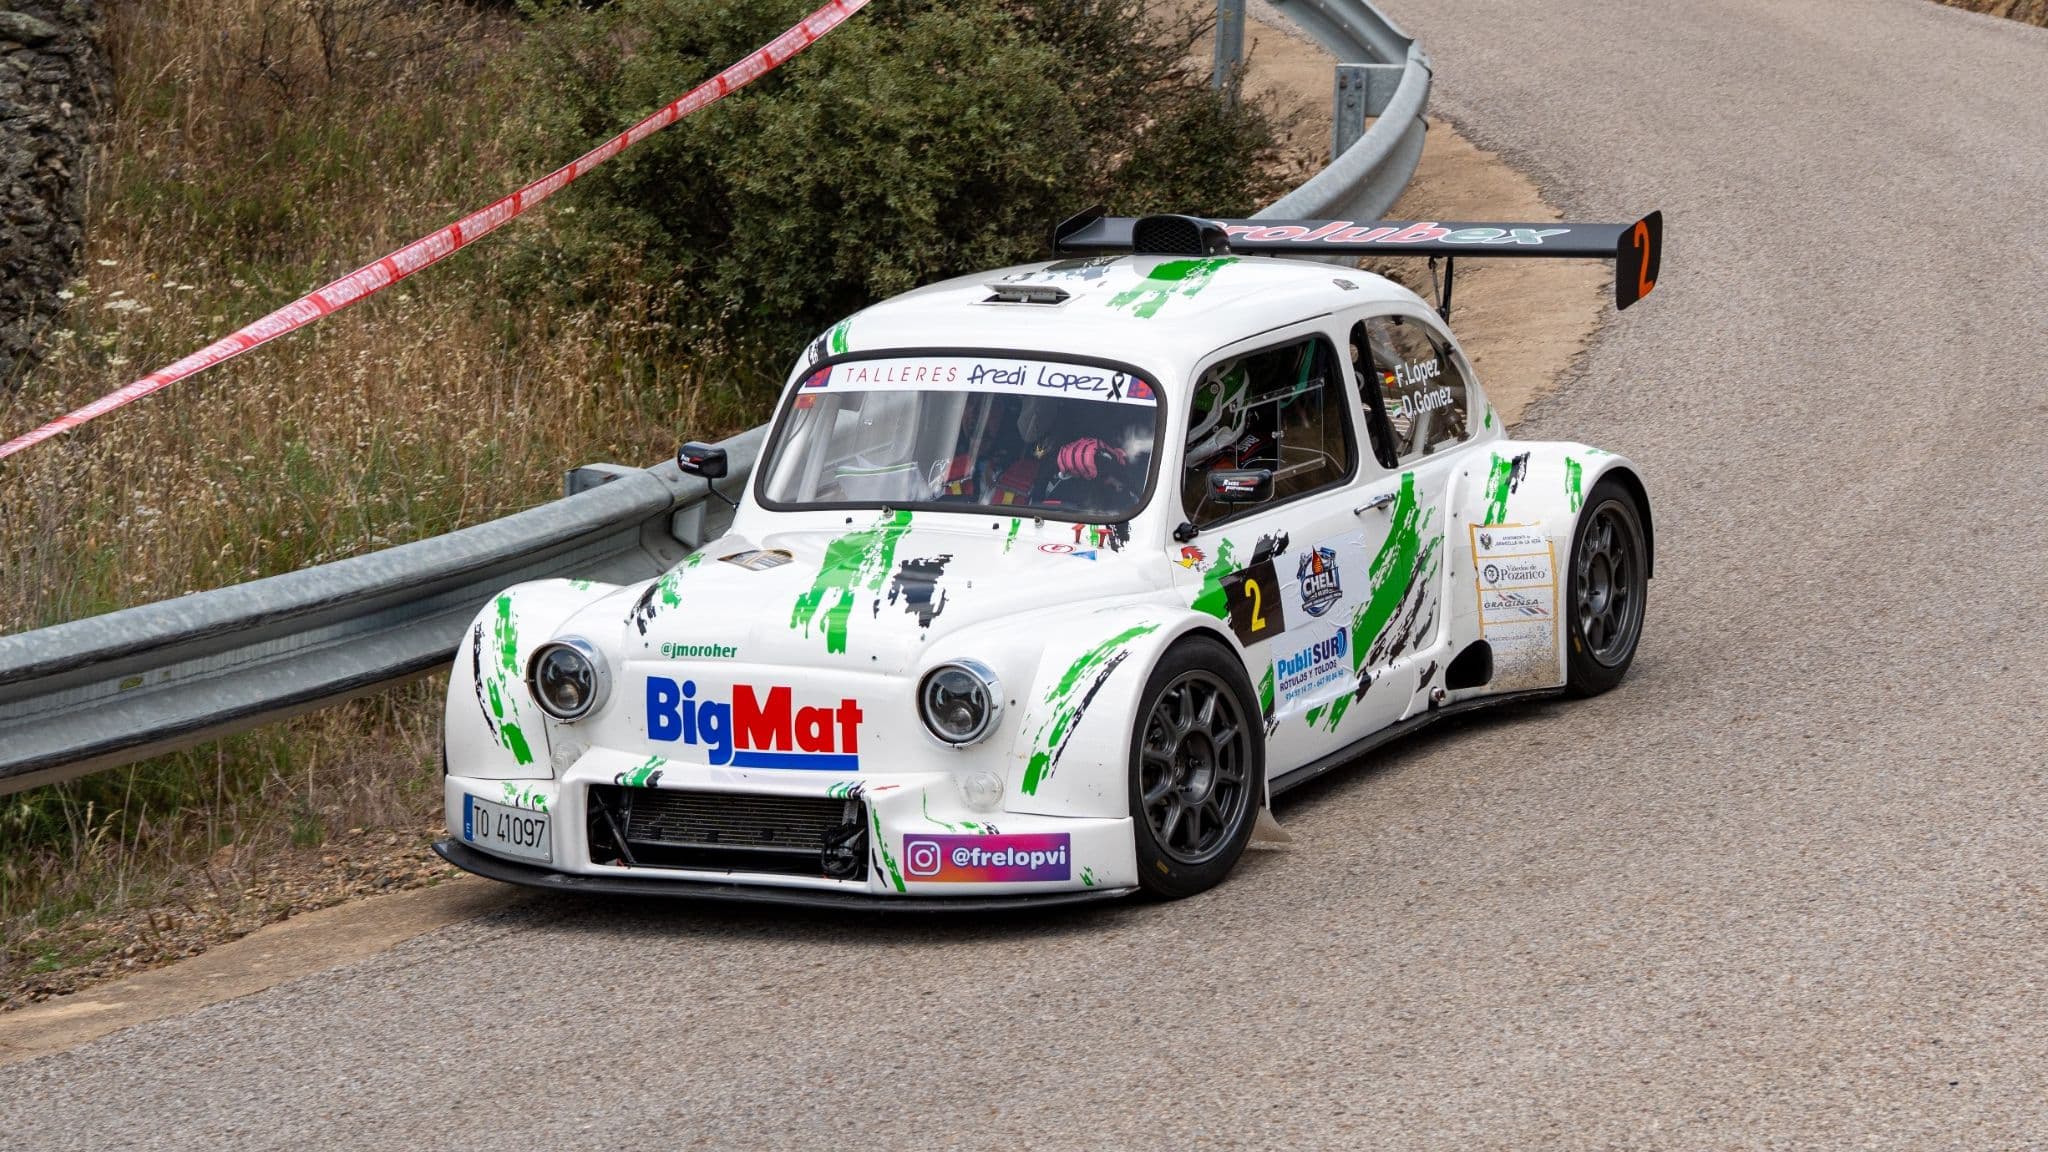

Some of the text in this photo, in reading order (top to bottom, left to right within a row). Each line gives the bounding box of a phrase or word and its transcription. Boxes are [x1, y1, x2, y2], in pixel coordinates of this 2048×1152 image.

[1213, 221, 1571, 244] rolubex
[1634, 220, 1653, 299] 2
[846, 366, 957, 383] TALLERES
[1037, 366, 1108, 392] Lopez
[1395, 359, 1441, 388] F.López
[1402, 386, 1454, 419] D.Gómez
[1500, 569, 1545, 581] Pozanco
[1245, 578, 1266, 633] 2
[661, 642, 738, 659] @jmoroher
[1277, 634, 1340, 681] PubliSUR
[646, 675, 864, 766] BigMat
[474, 805, 545, 849] TO 41097
[951, 845, 1066, 871] @frelopvi
